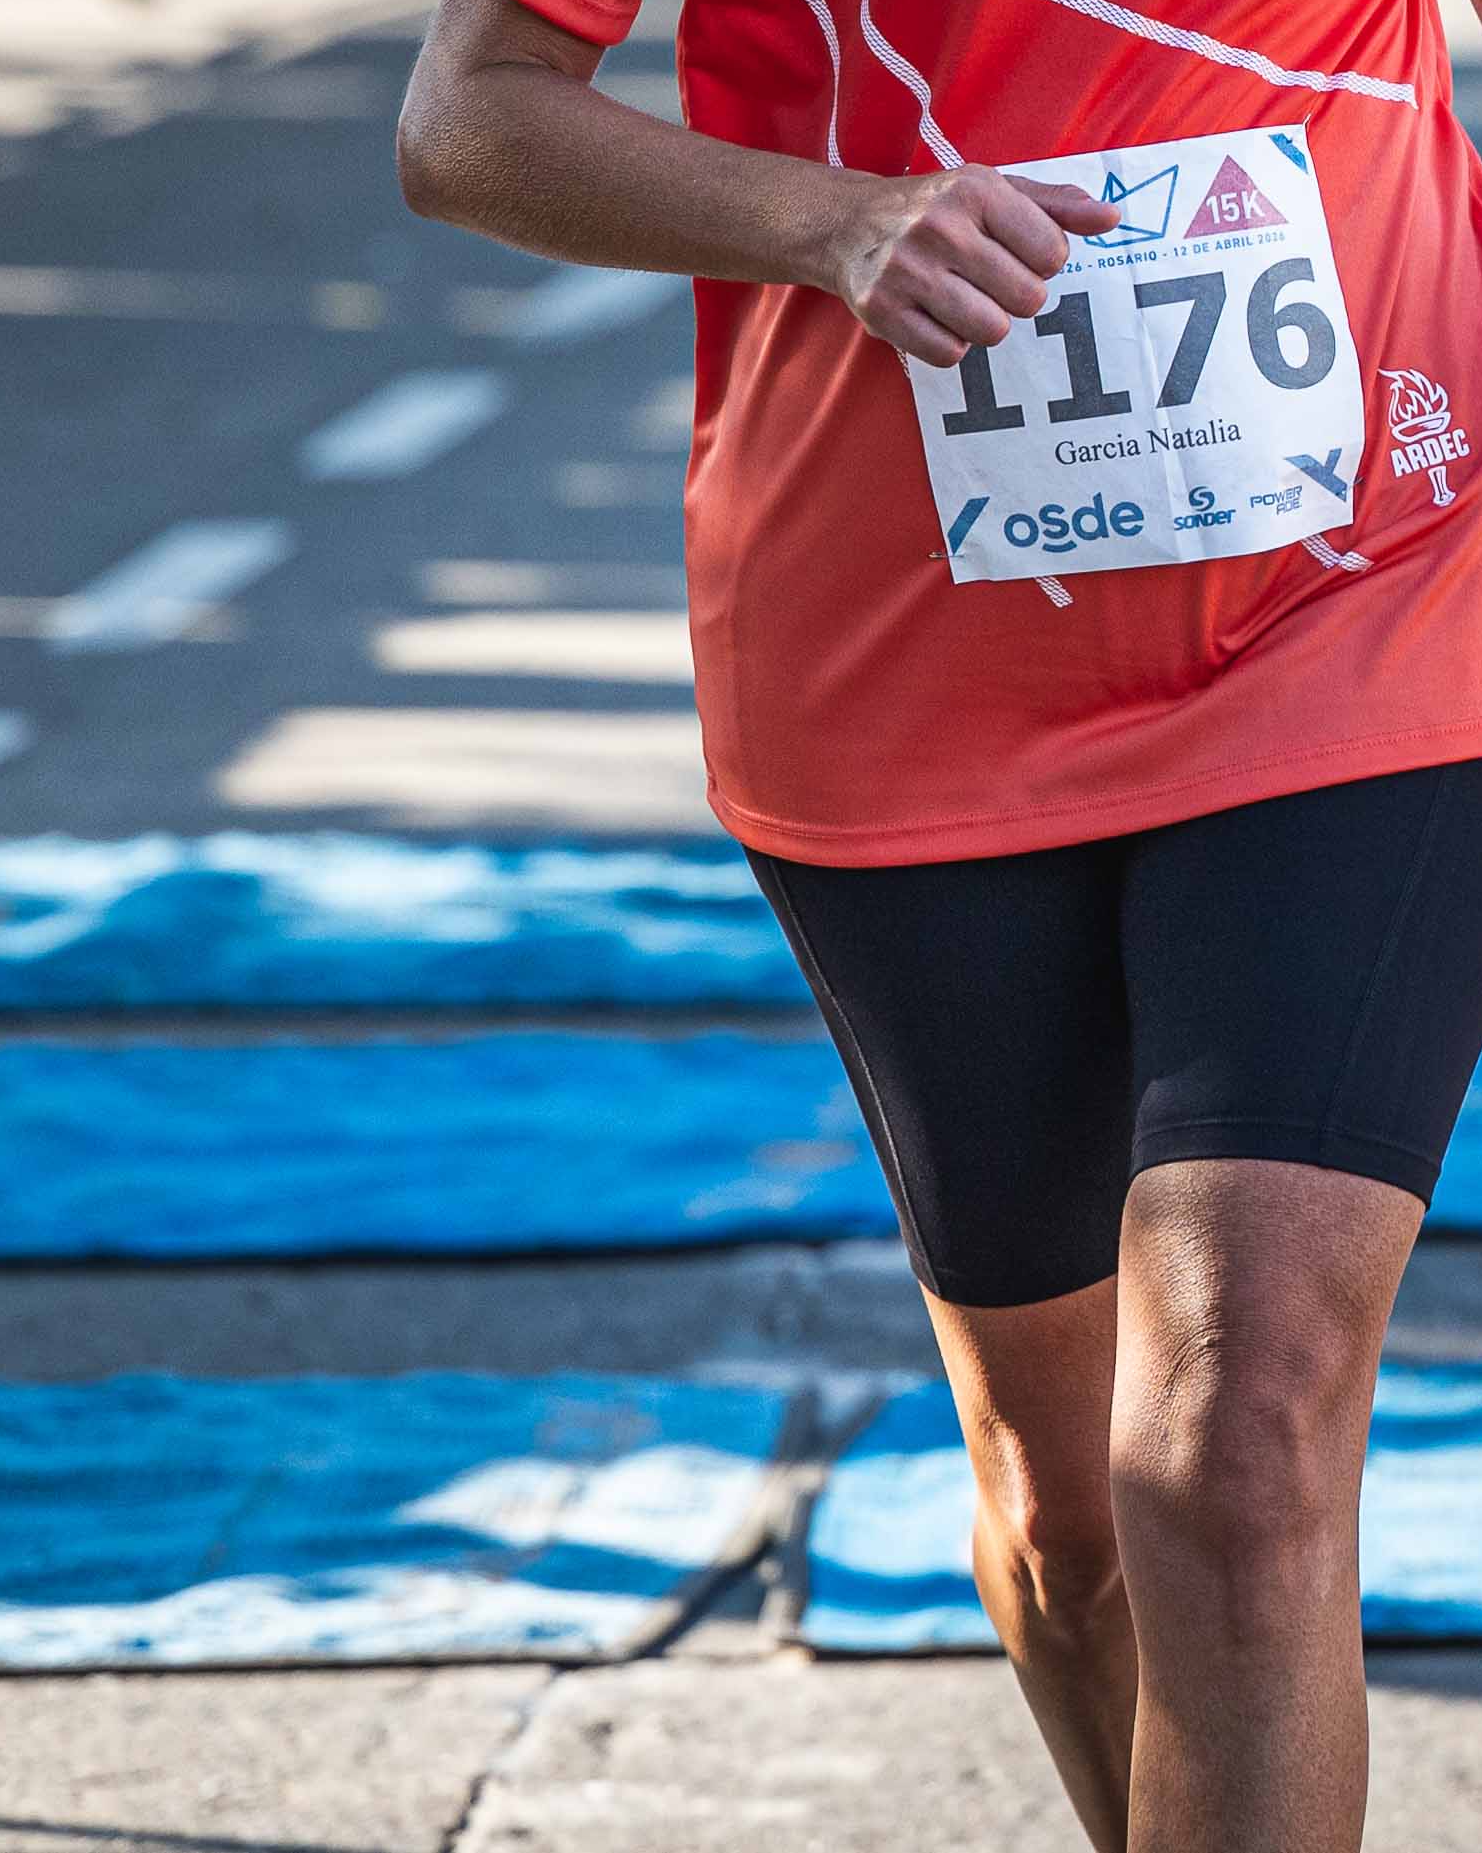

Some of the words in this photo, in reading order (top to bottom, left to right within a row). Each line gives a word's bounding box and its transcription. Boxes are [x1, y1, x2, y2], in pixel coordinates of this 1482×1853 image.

[1204, 189, 1267, 224] 15K
[1097, 251, 1158, 269] ROSARIO
[1173, 246, 1188, 257] 12
[1193, 242, 1210, 254] DE
[1215, 235, 1254, 250] ABRIL
[942, 257, 1338, 436] 1176
[1055, 433, 1141, 467] Garcia
[1148, 419, 1243, 455] Natalia
[1390, 428, 1470, 478] ARDEC
[1250, 485, 1303, 509] POWER
[1004, 492, 1146, 553] osde
